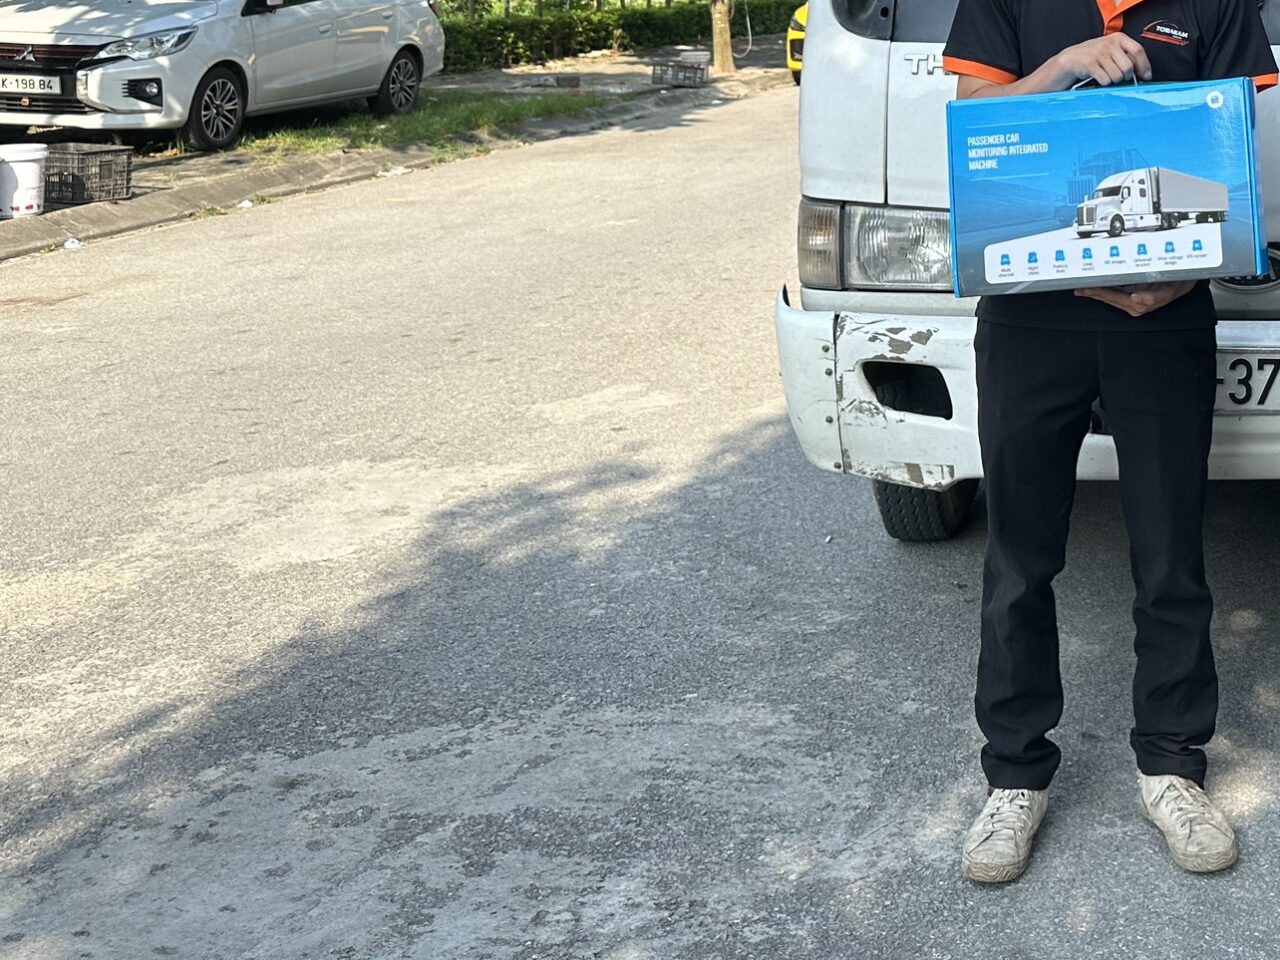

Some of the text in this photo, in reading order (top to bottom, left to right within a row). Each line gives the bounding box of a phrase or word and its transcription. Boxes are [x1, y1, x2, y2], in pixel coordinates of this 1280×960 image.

[968, 132, 1019, 147] PASSENGER CAR
[968, 143, 1048, 159] MONITORING INTEGRATED
[968, 159, 998, 171] MACHINE
